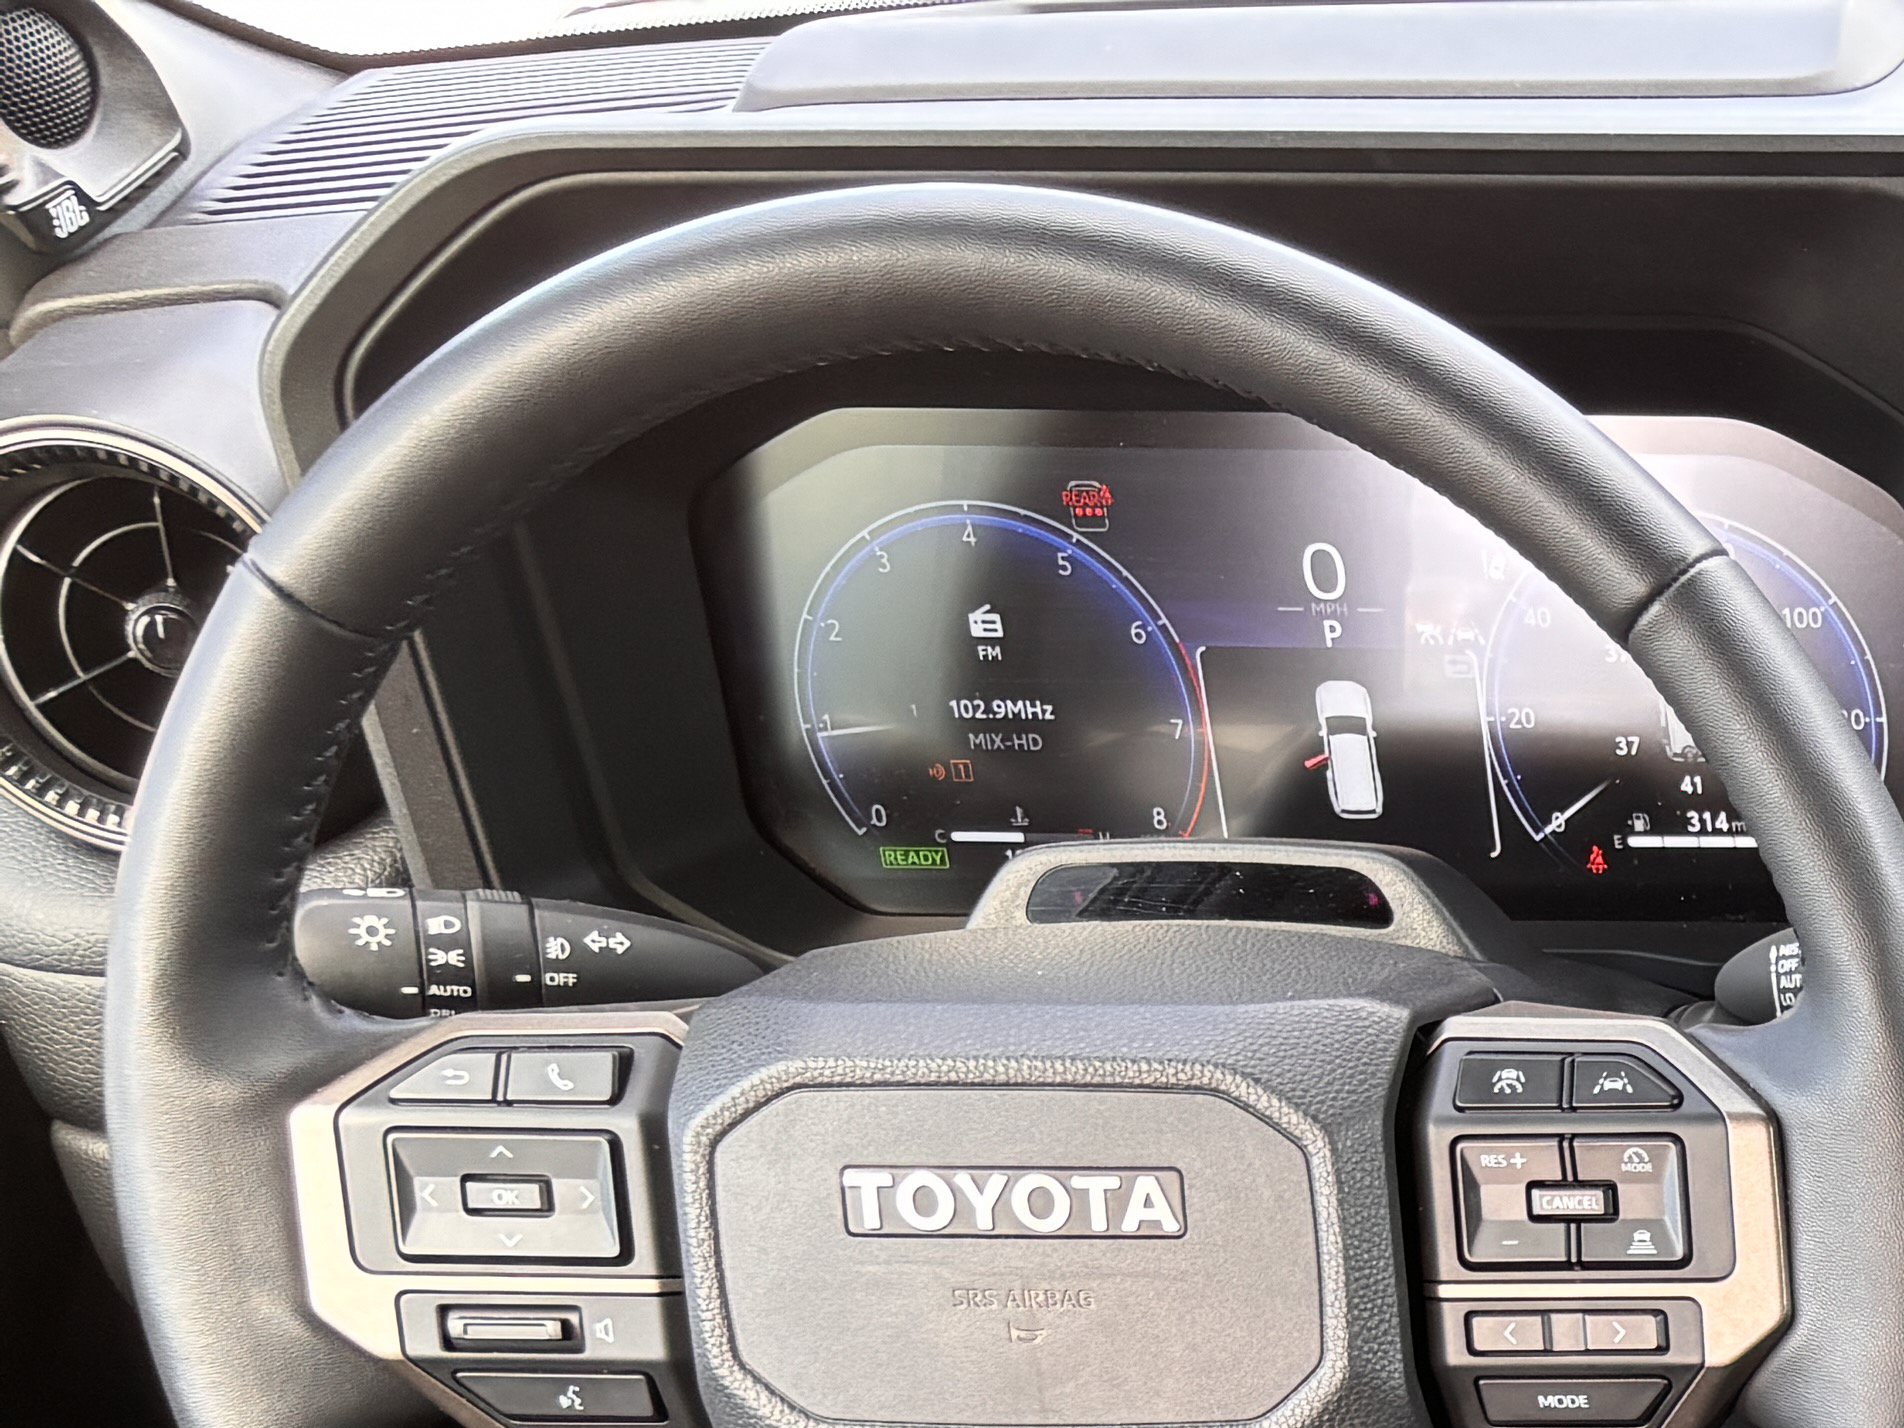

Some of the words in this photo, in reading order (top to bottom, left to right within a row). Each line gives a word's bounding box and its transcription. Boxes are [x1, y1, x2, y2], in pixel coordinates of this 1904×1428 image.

[45, 190, 90, 238] JBL
[1062, 491, 1100, 506] REAR
[961, 524, 977, 547] 4
[876, 552, 892, 573] 3
[1058, 553, 1072, 576] 5
[1302, 542, 1347, 601] 0
[1310, 603, 1348, 618] MPH
[1523, 609, 1551, 628] 40
[1781, 607, 1822, 629] 100
[826, 621, 843, 641] 2
[1130, 622, 1147, 643] 6
[1323, 619, 1343, 648] P
[977, 645, 1002, 661] FM
[949, 699, 1056, 722] 102.9MHz
[1508, 709, 1535, 729] 20
[1169, 719, 1184, 740] 7
[969, 733, 1043, 752] MIX-HD
[1615, 737, 1640, 756] 37
[1680, 775, 1703, 795] 41
[872, 805, 887, 827] 0
[1153, 808, 1166, 830] 8
[1686, 810, 1729, 833] 314
[1613, 834, 1624, 849] E
[886, 849, 942, 866] READY
[1779, 943, 1801, 956] MIS
[1778, 959, 1800, 973] OFF
[545, 973, 578, 987] OFF
[1780, 974, 1802, 989] AUT
[427, 984, 473, 997] AUTO
[1480, 1154, 1508, 1168] RES
[1621, 1162, 1653, 1173] MODE
[492, 1190, 520, 1204] OK
[842, 1169, 1181, 1232] TOYOTA
[1541, 1196, 1600, 1211] CANCEL
[951, 1289, 999, 1310] SRS
[1005, 1289, 1095, 1310] AIRBAG
[1538, 1394, 1589, 1408] MODE
